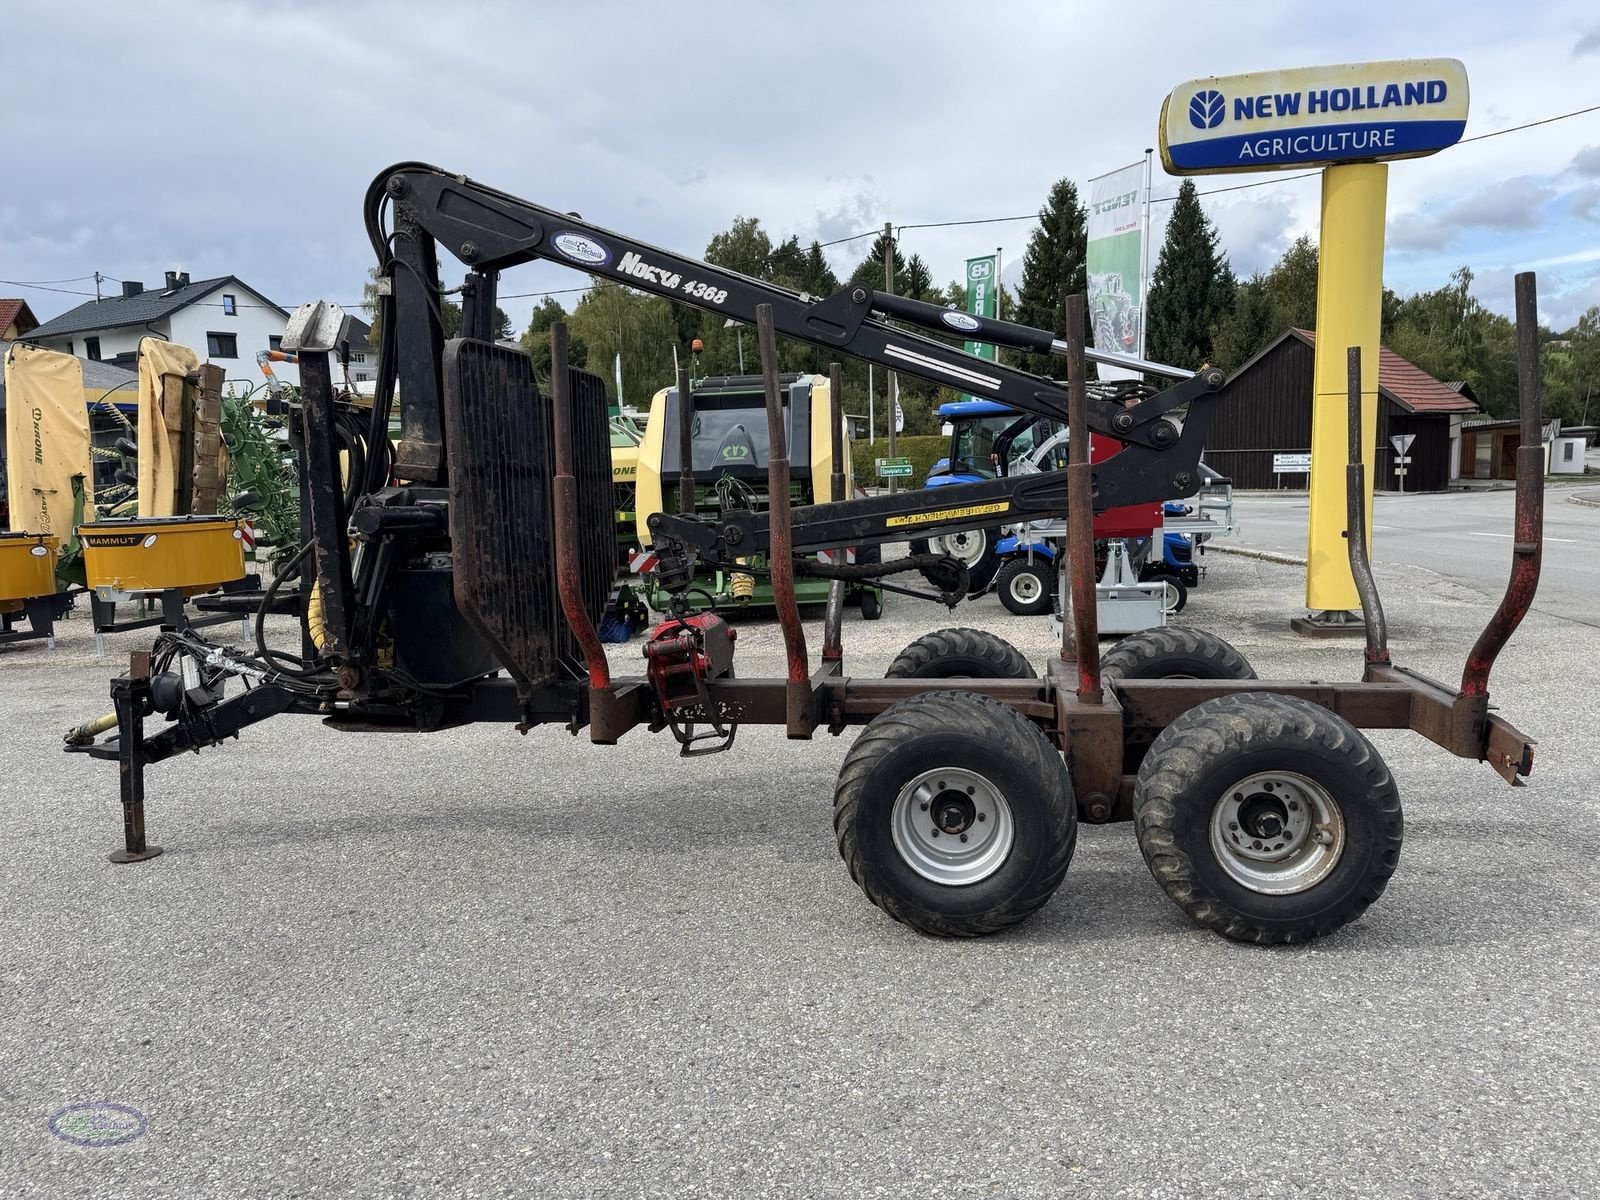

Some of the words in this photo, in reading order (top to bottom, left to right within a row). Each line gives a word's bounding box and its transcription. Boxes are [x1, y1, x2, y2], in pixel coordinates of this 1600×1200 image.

[1234, 92, 1301, 121] NEW
[1308, 79, 1448, 114] HOLLAND
[1238, 128, 1396, 160] AGRICULTURE
[581, 245, 603, 260] Technik
[682, 279, 728, 305] 4368
[33, 421, 43, 465] KRONE
[613, 466, 637, 476] ONE
[89, 537, 136, 545] MAMMUT
